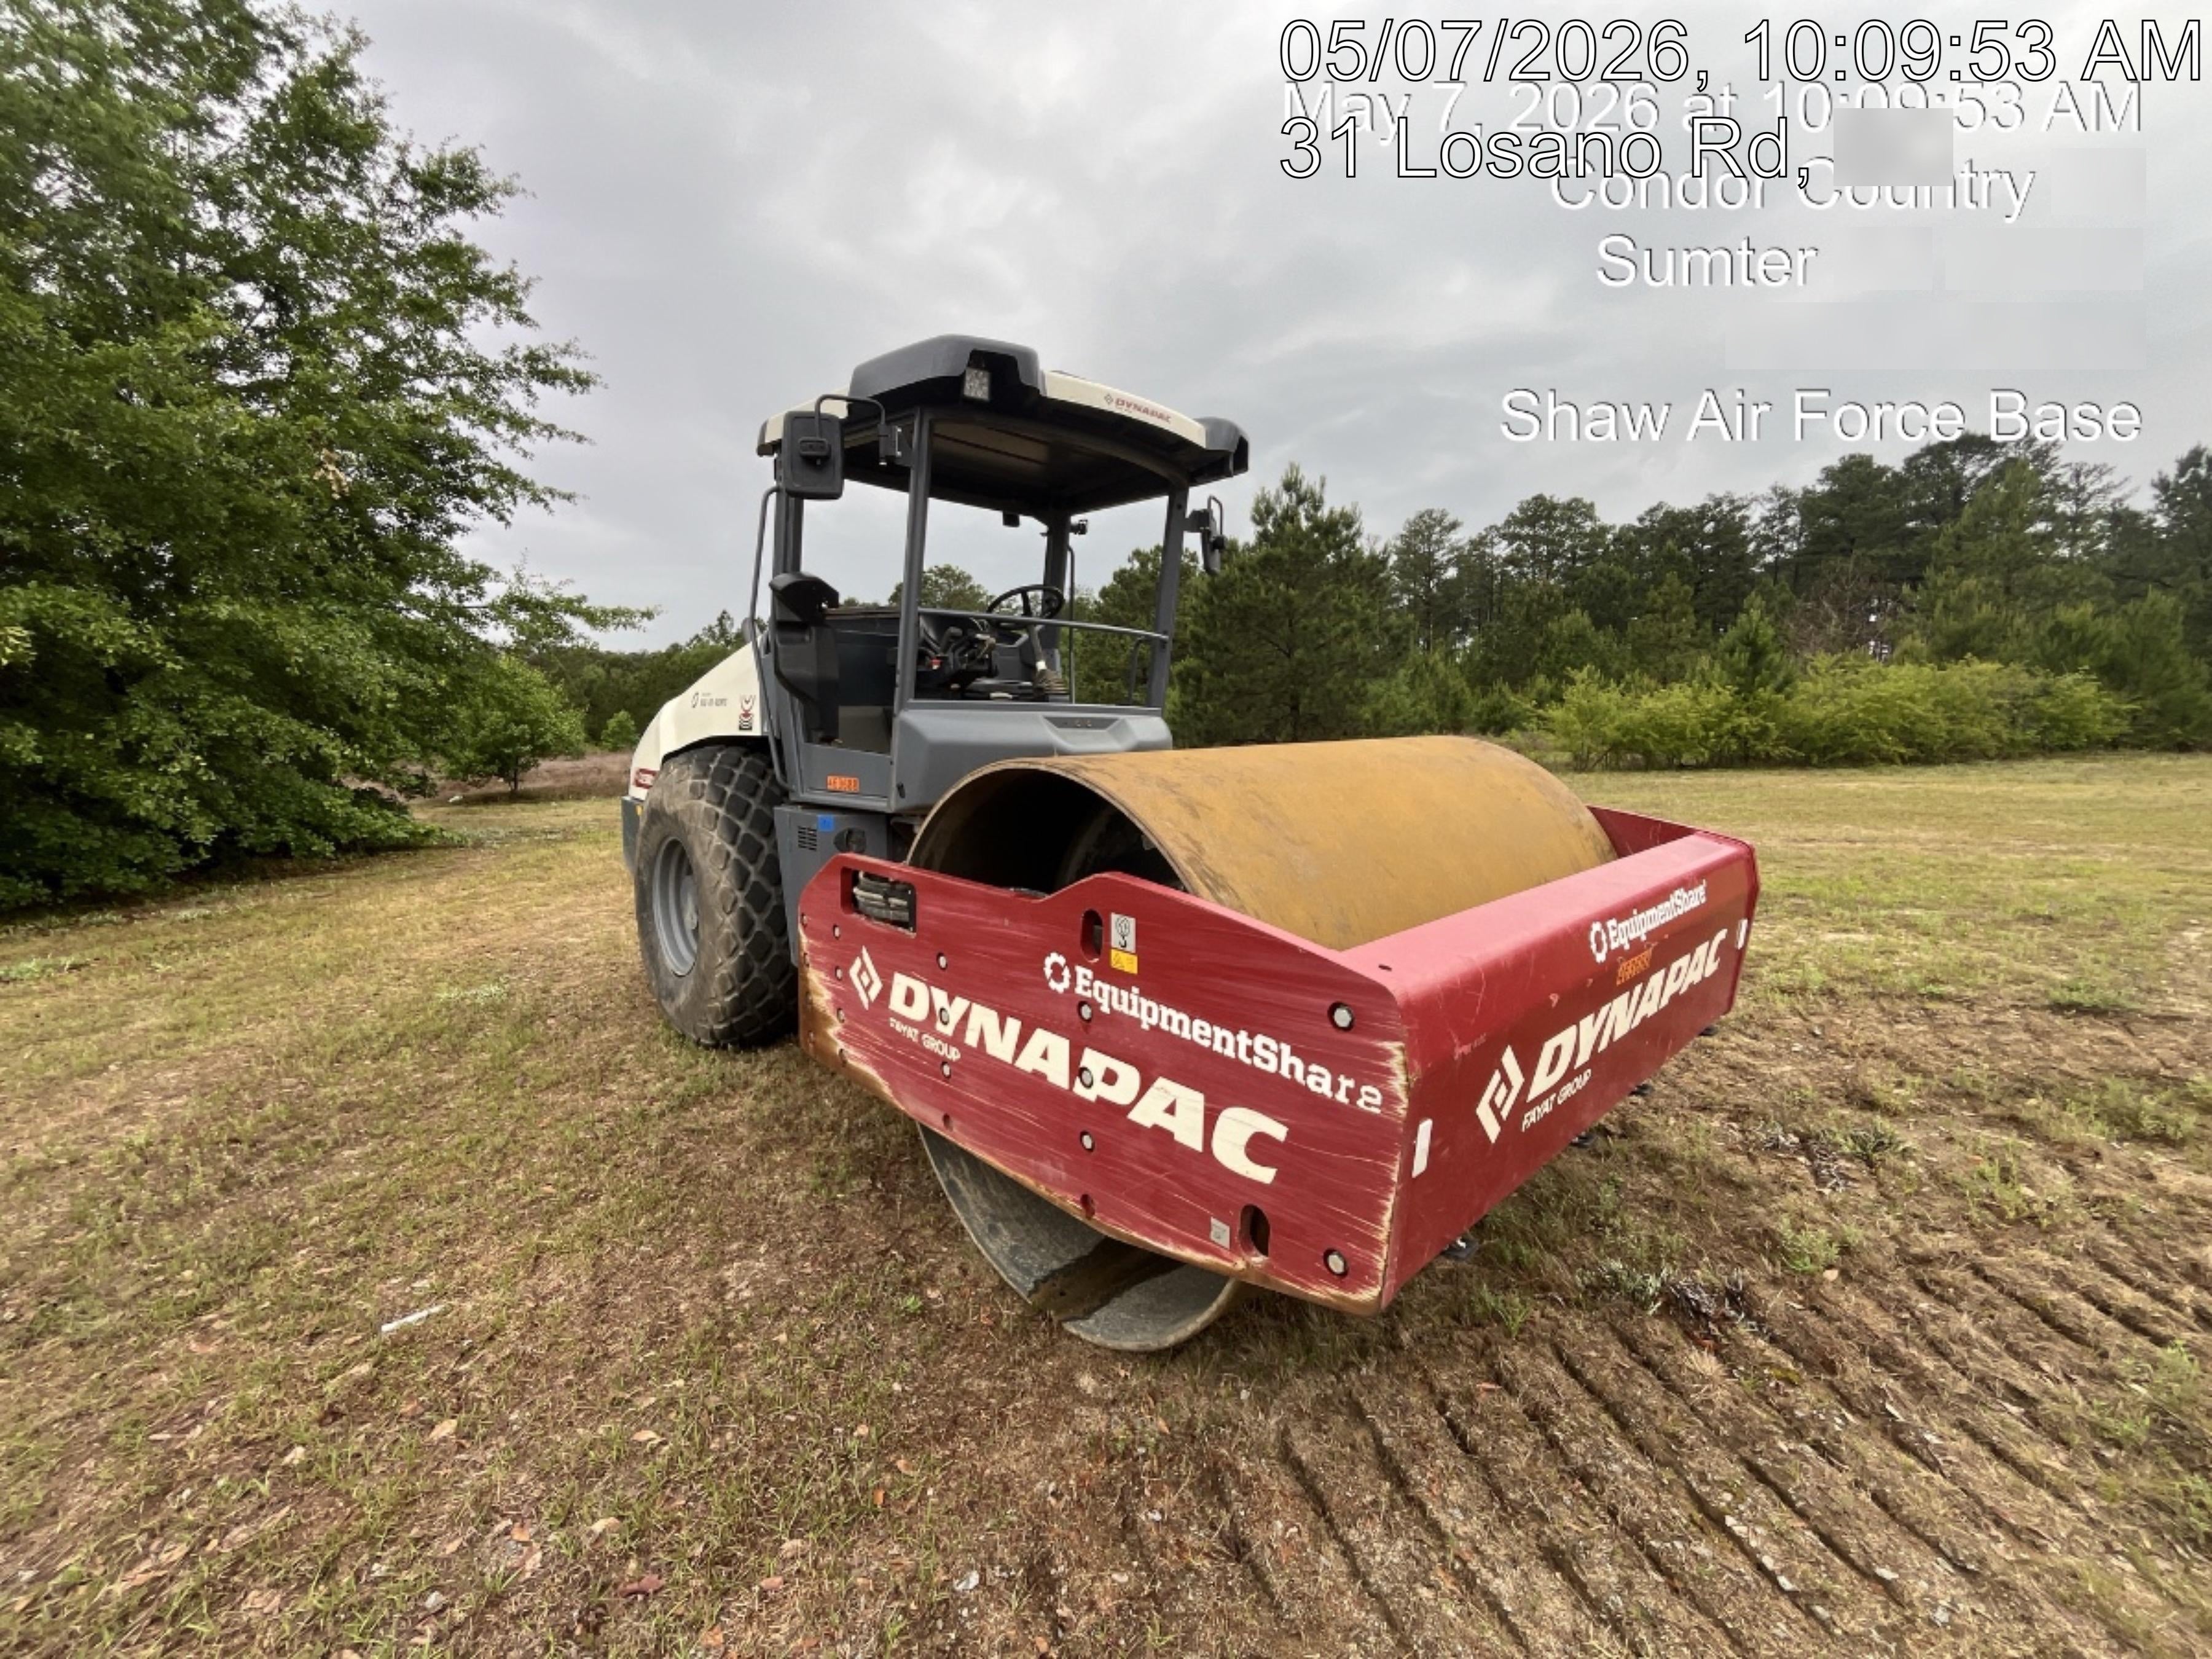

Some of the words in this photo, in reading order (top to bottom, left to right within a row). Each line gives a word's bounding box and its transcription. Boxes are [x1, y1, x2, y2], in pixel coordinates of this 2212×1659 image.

[1606, 884, 1707, 951] EquipmentShare
[921, 1033, 961, 1062] GROUP
[1074, 965, 1383, 1114] EquipmentShare
[1526, 928, 1728, 1103] DYNAPAC
[888, 971, 1289, 1185] DYNAPAC
[1521, 1092, 1556, 1132] FAYAT
[1557, 1069, 1592, 1105] GROUP
